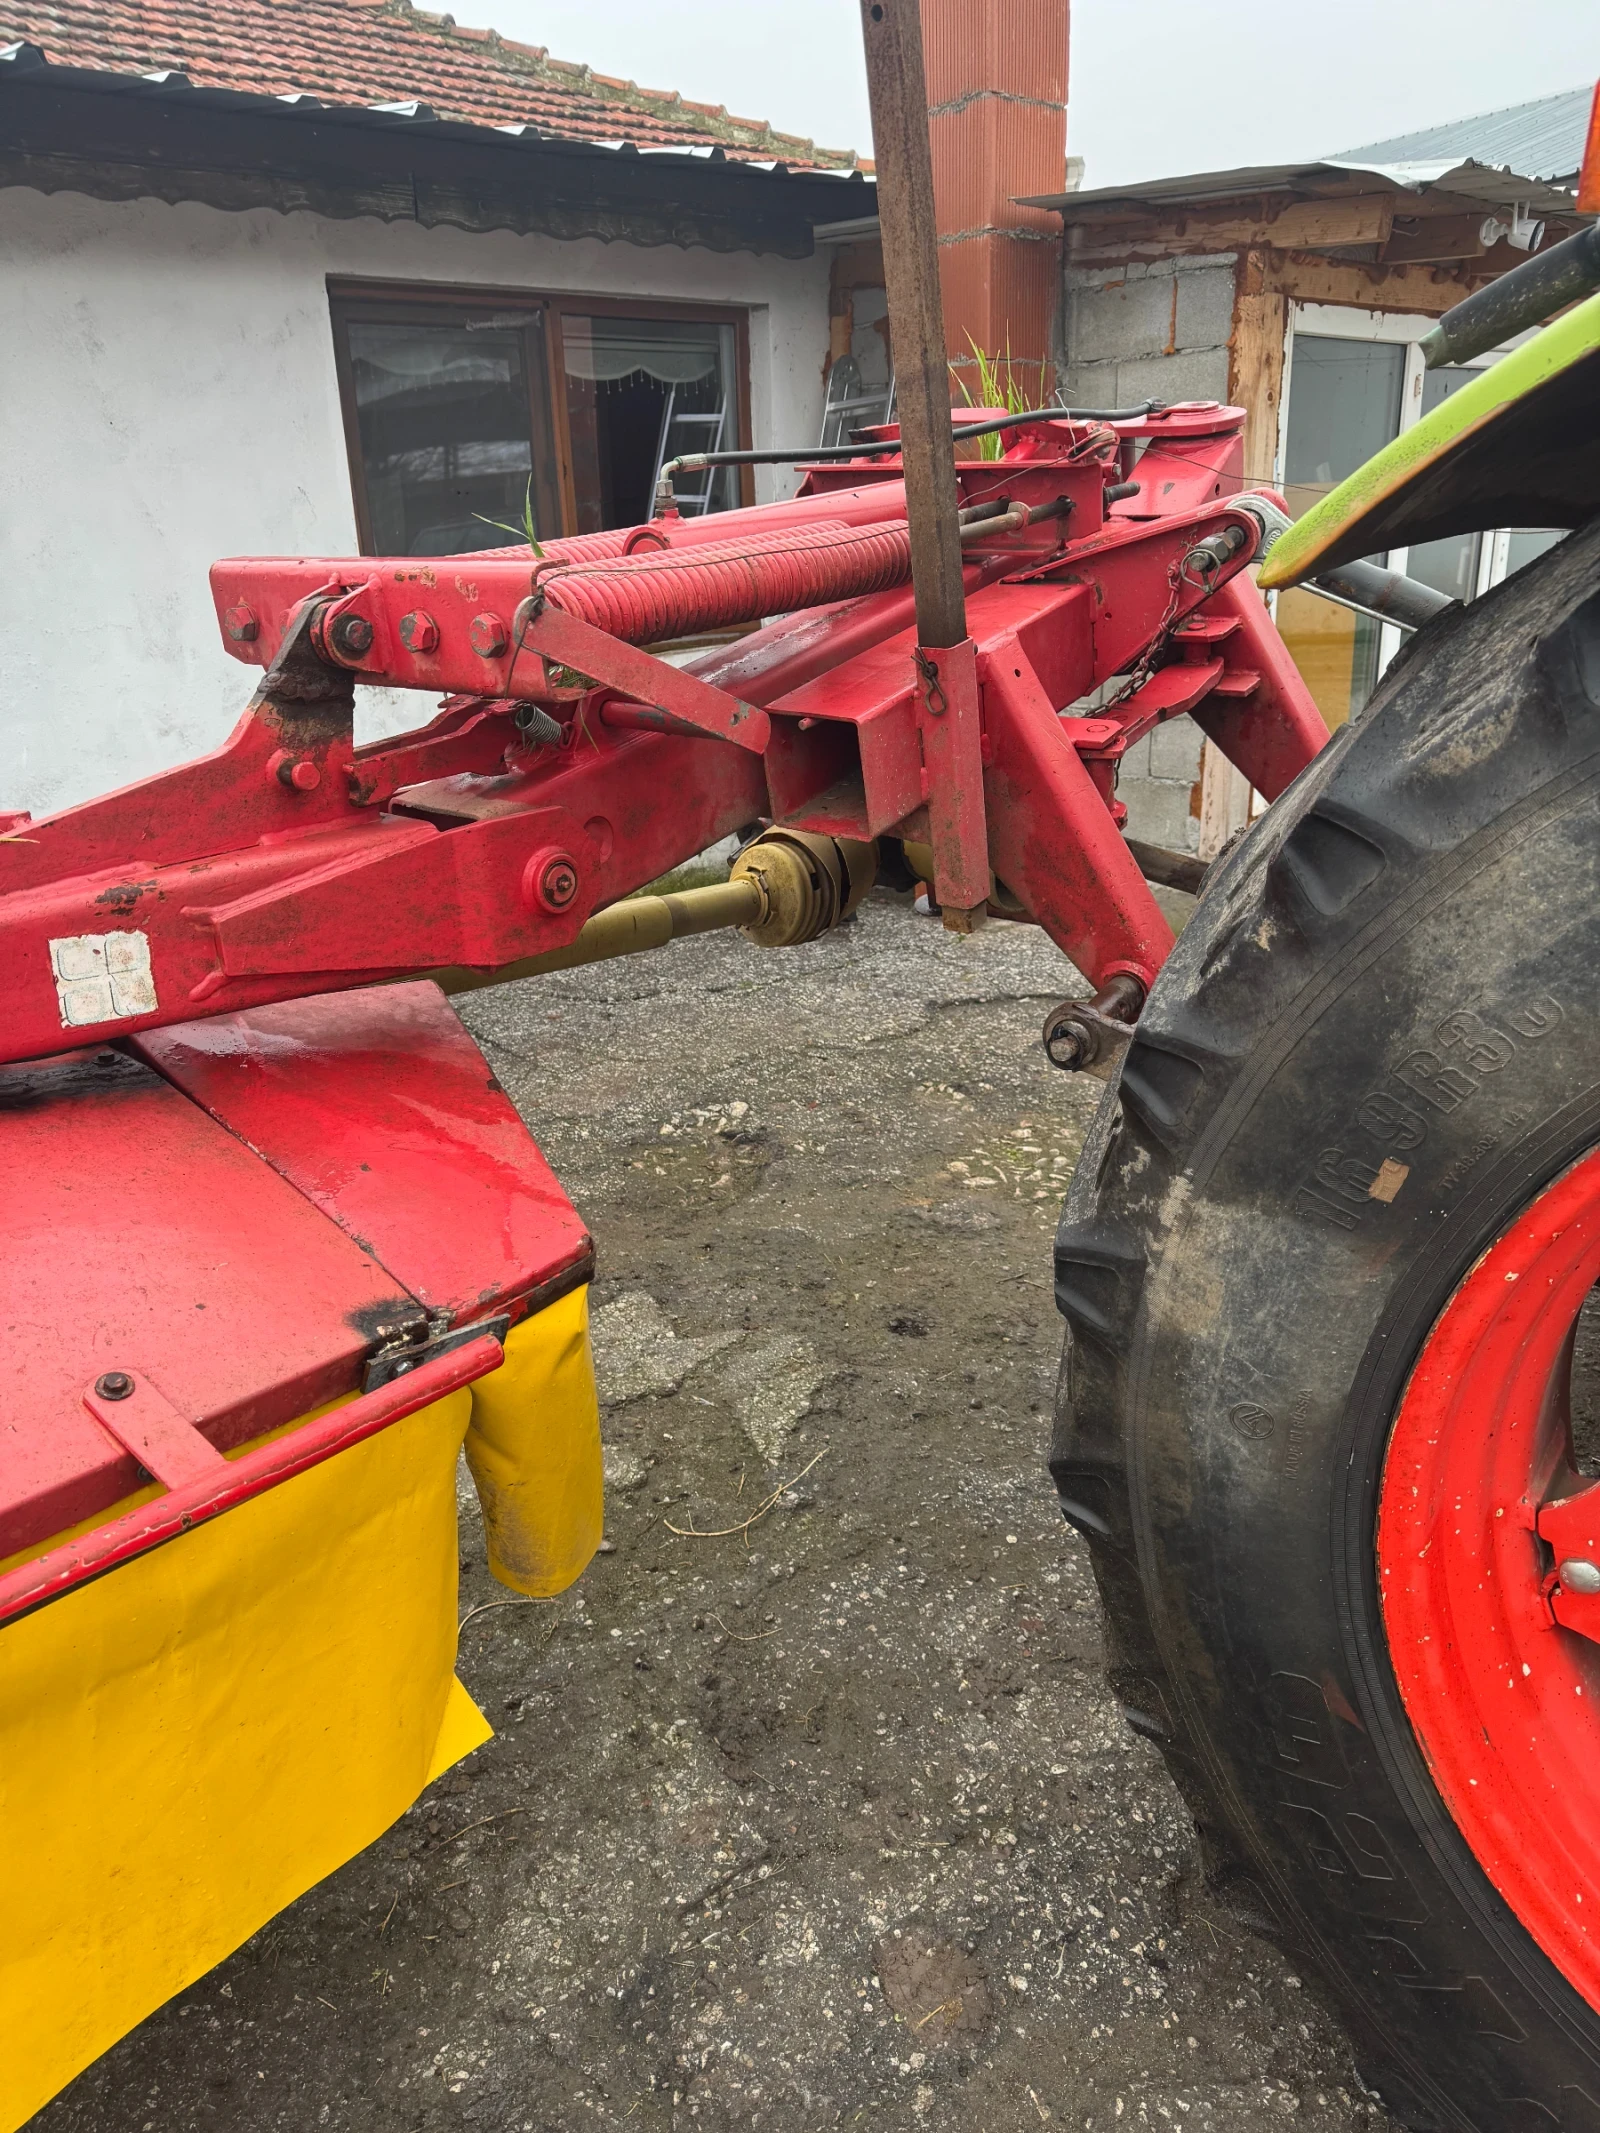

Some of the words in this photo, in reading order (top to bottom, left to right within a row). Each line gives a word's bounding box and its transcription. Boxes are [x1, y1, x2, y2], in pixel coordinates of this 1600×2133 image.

[1293, 1388, 1313, 1428] RUSSIA
[1289, 1430, 1302, 1443] IN
[1284, 1444, 1300, 1480] MADE
